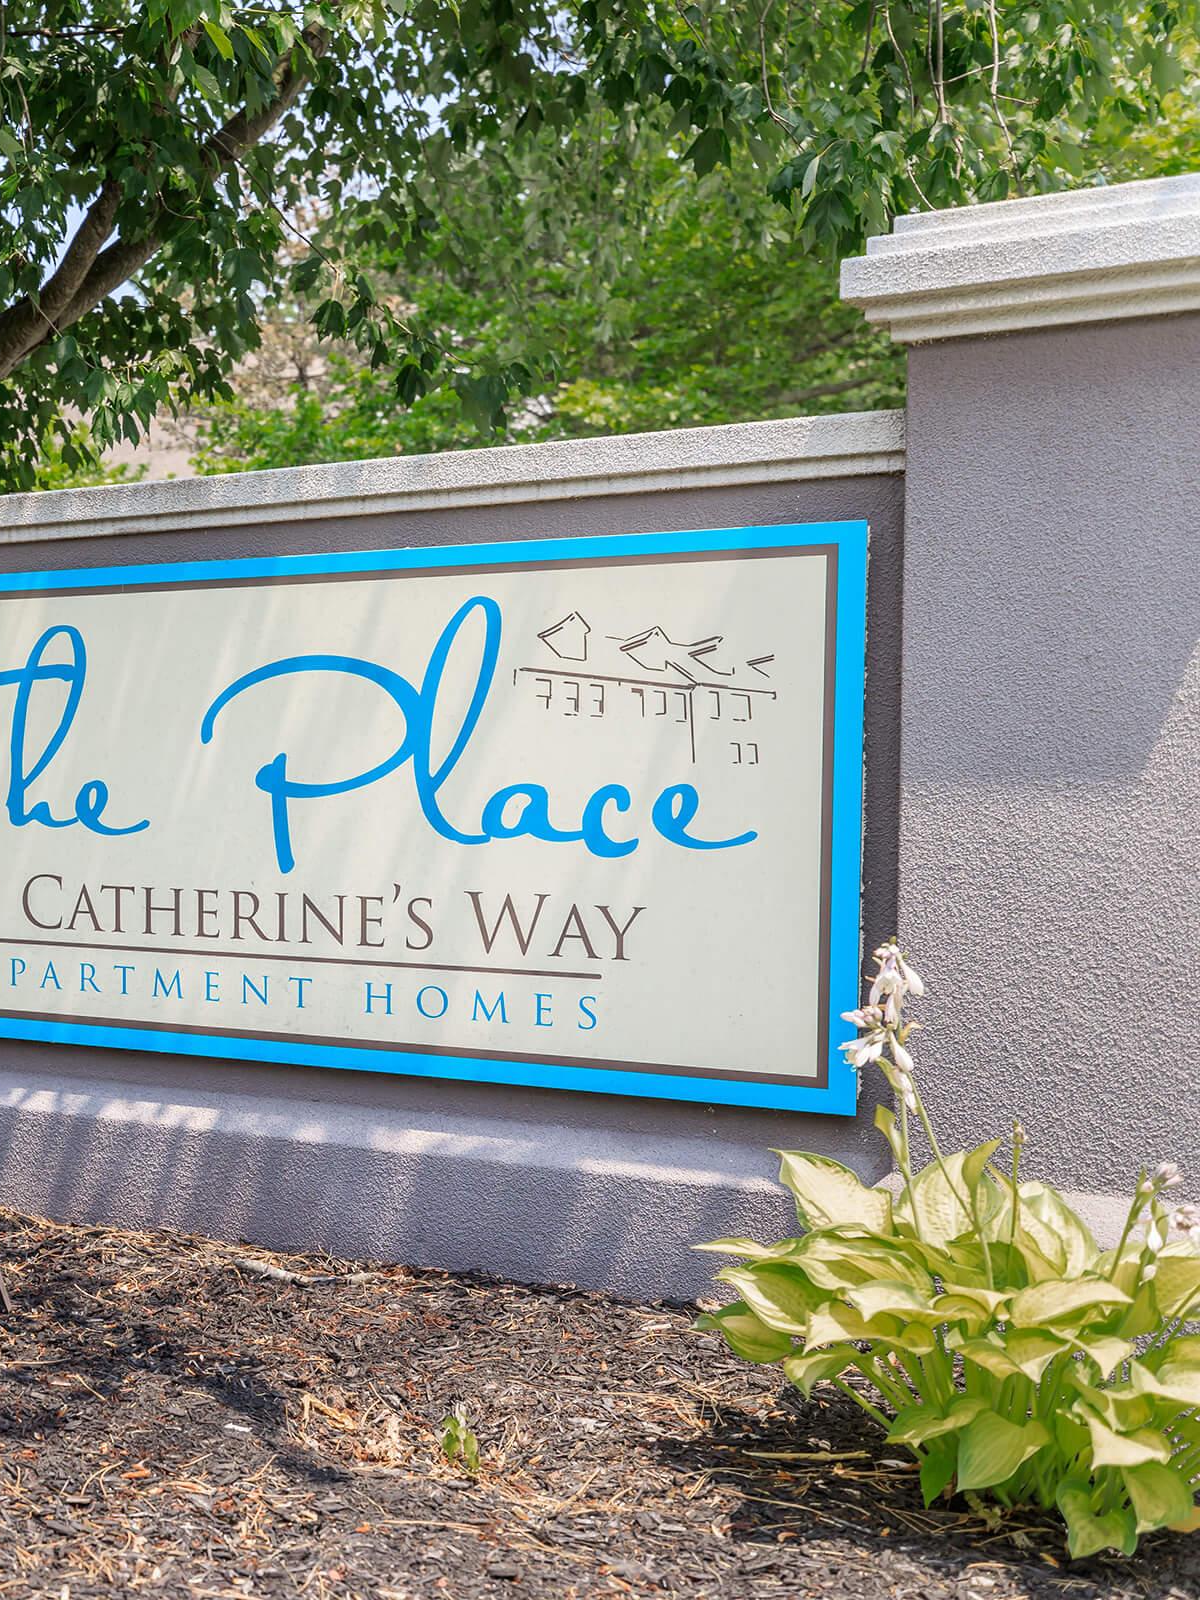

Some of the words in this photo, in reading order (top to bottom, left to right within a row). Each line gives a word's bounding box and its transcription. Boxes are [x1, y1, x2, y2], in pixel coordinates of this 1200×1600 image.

[200, 595, 758, 874] Place
[21, 873, 435, 951] CATHERINE'S
[463, 890, 648, 961] WAY
[364, 982, 598, 1031] HOMES
